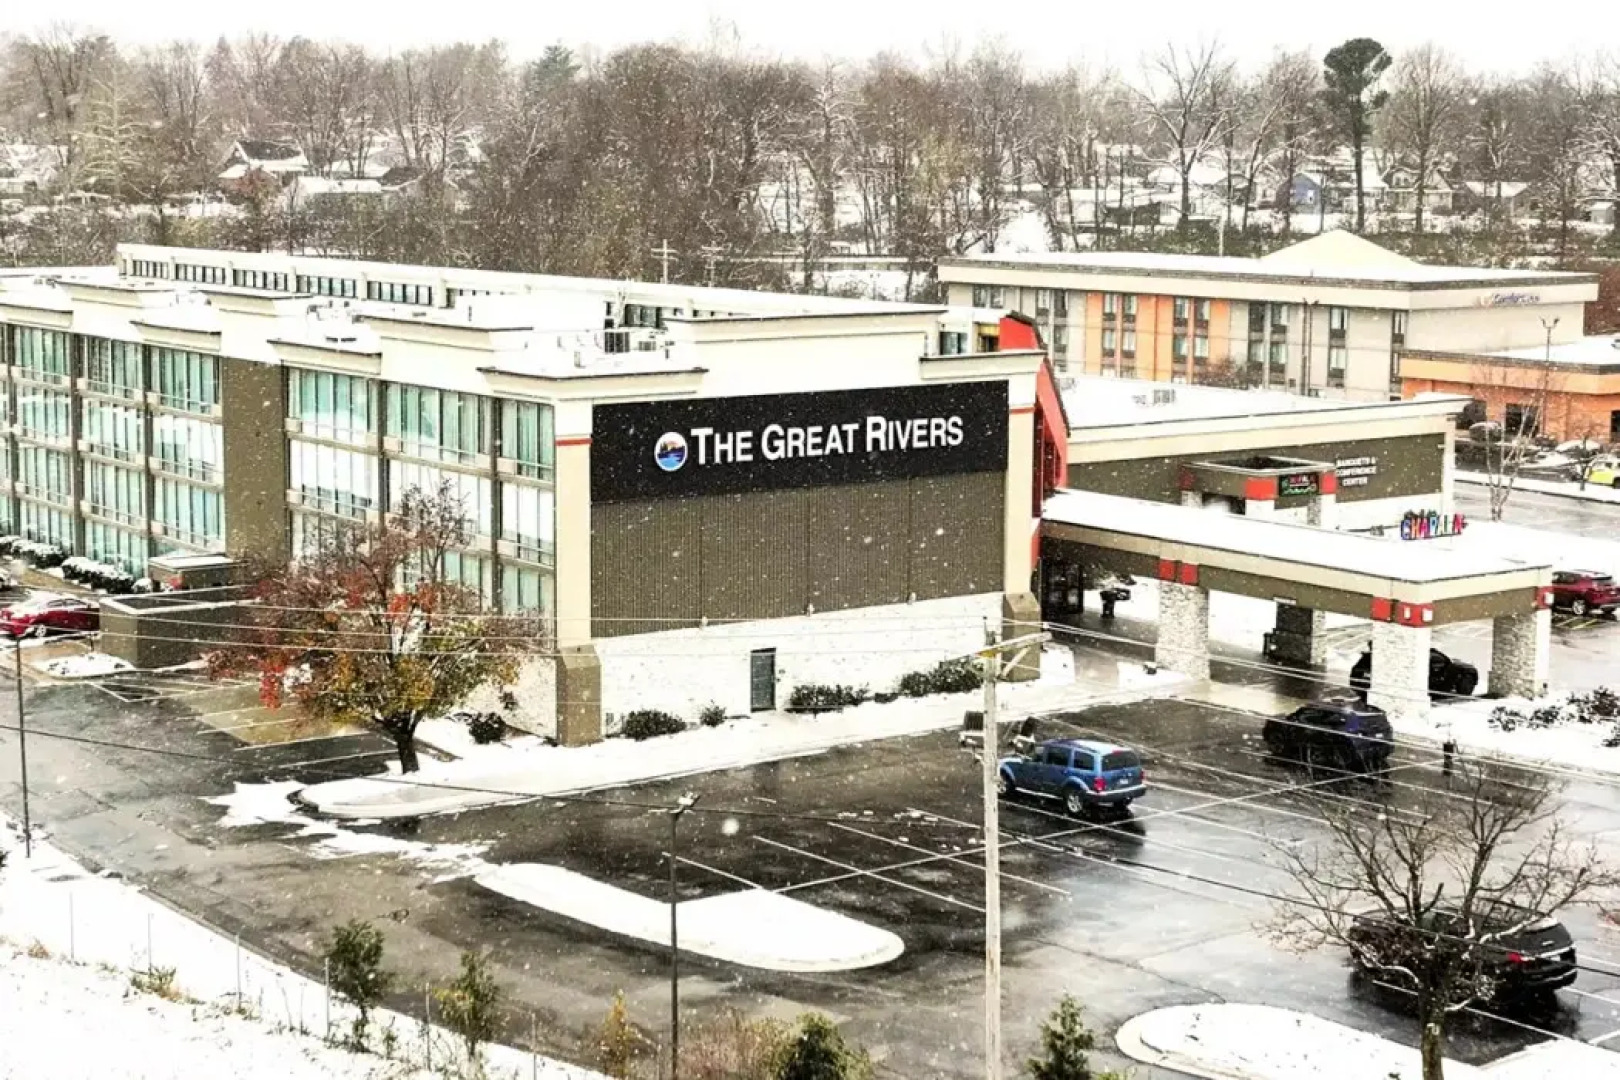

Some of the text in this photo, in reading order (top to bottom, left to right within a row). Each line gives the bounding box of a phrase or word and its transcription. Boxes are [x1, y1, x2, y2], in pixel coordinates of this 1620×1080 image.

[691, 416, 964, 465] THE GREAT RIVERS
